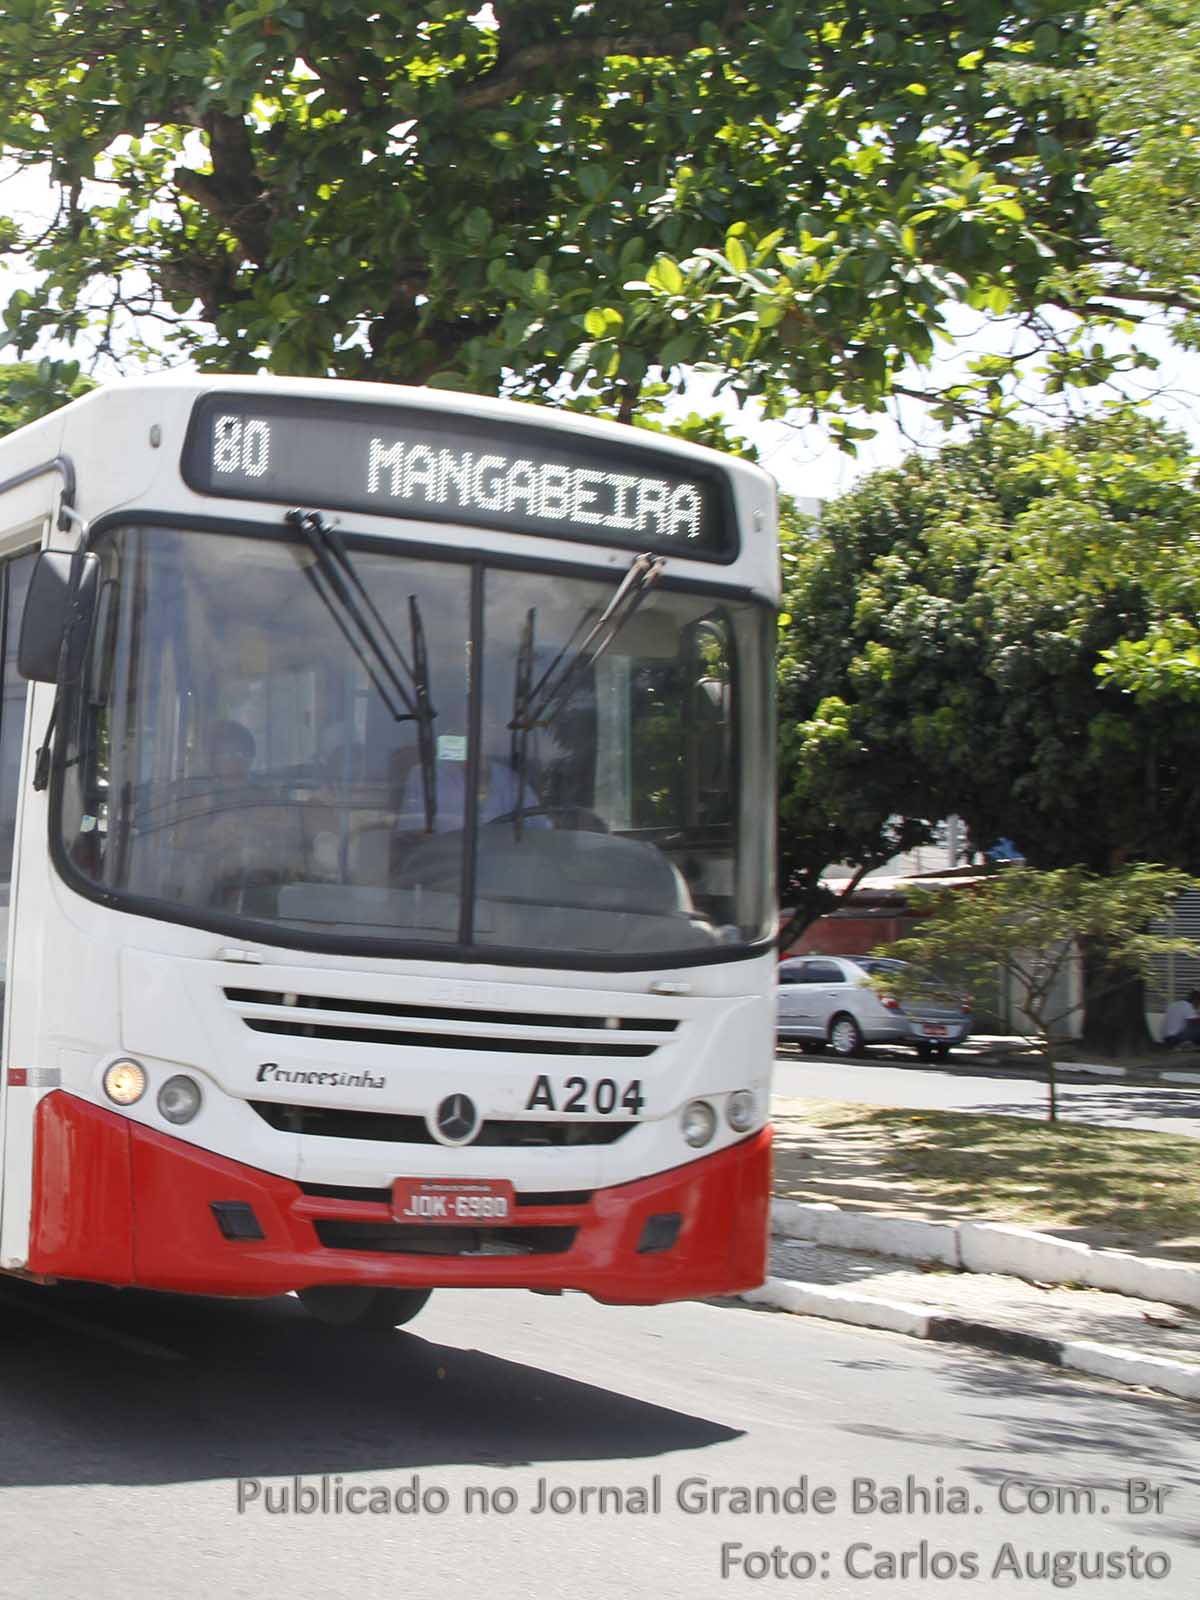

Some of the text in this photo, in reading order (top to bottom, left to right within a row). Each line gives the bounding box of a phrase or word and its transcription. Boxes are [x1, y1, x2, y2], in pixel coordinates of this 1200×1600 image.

[213, 415, 702, 539] 80 MANGABEIRA
[524, 1074, 647, 1116] A204
